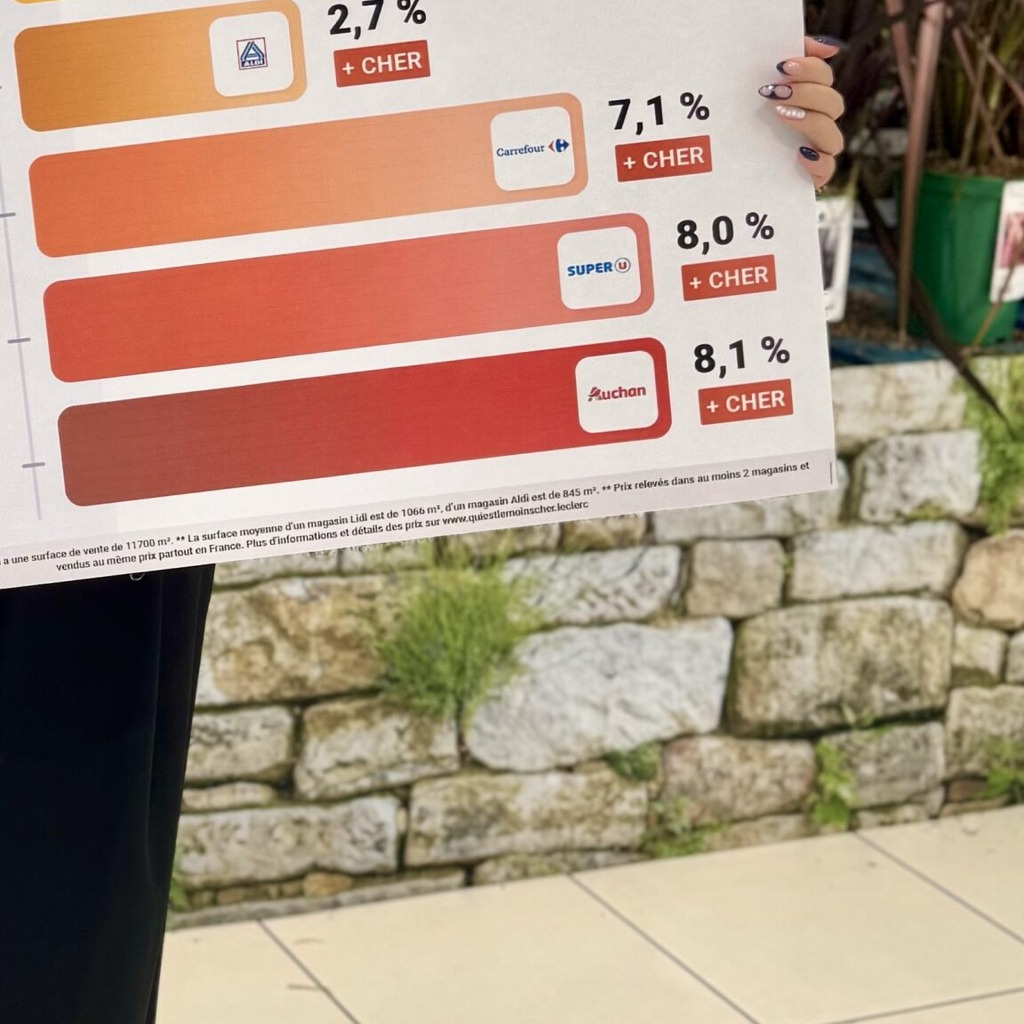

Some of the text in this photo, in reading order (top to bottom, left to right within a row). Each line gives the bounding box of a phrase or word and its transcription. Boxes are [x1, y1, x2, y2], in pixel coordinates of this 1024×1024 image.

[242, 59, 264, 67] ALDI
[342, 51, 422, 75] + CHER
[608, 92, 710, 136] 7,1 %
[496, 143, 545, 158] Carrefour
[623, 146, 704, 169] + CHER
[677, 212, 774, 255] 8,0 %
[567, 261, 613, 277] SUPER
[689, 266, 768, 289] + CHER
[694, 336, 790, 379] 8,1 %
[588, 385, 646, 402] Auchan
[706, 390, 785, 413] + CHER
[11, 556, 29, 564] une
[31, 549, 67, 562] surface
[69, 547, 81, 557] de
[83, 545, 110, 555] vente
[111, 543, 123, 552] de
[126, 539, 156, 550] 11700
[157, 537, 174, 546] m².
[187, 534, 200, 543] La
[202, 530, 238, 541] surface
[239, 525, 283, 537] moyenne
[285, 521, 306, 531] d'un
[307, 516, 348, 529] magasin
[350, 513, 368, 523] Lidl
[370, 512, 385, 521] est
[386, 510, 399, 519] de
[401, 507, 425, 517] 1066
[427, 505, 443, 514] m²,
[445, 502, 466, 512] d'un
[467, 496, 509, 510] magasin
[510, 493, 529, 504] Aldi
[531, 492, 547, 502] est
[548, 490, 561, 500] de
[563, 488, 581, 498] 845
[583, 486, 599, 496] m².
[613, 482, 633, 492] Prix
[634, 478, 670, 489] relevés
[671, 476, 695, 486] dans
[697, 475, 709, 483] au
[711, 470, 741, 481] moins
[751, 463, 798, 477] magasins
[800, 462, 810, 470] et
[56, 560, 91, 571] vendus
[93, 559, 105, 567] au
[106, 555, 137, 565] même
[138, 551, 157, 564] prix
[158, 547, 193, 561] partout
[195, 547, 207, 555] en
[209, 542, 244, 553] France.
[246, 539, 268, 548] Plus
[269, 531, 338, 546] d'informations
[340, 529, 350, 537] et
[351, 524, 384, 536] détails
[385, 523, 403, 532] des
[405, 520, 423, 532] prix
[425, 519, 440, 527] sur
